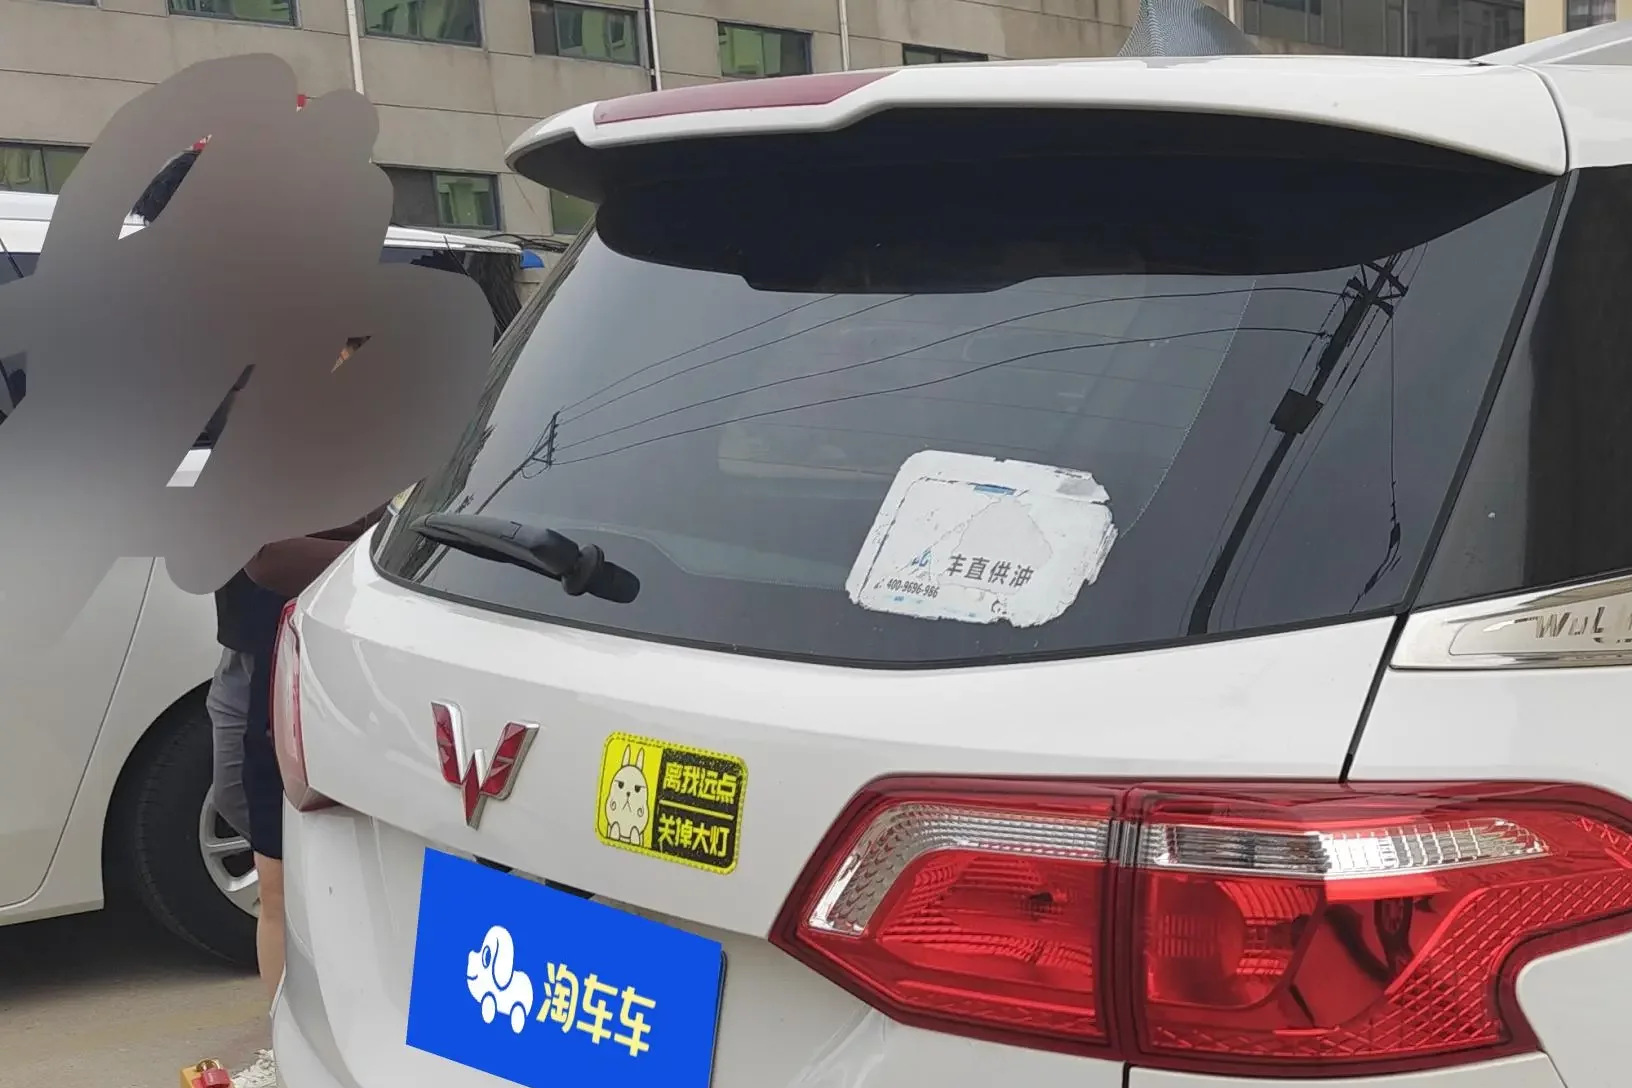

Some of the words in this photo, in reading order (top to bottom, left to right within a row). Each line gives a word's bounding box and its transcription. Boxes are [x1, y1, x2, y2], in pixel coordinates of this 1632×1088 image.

[662, 762, 737, 804] 离我远点
[657, 813, 730, 858] 关掉大灯
